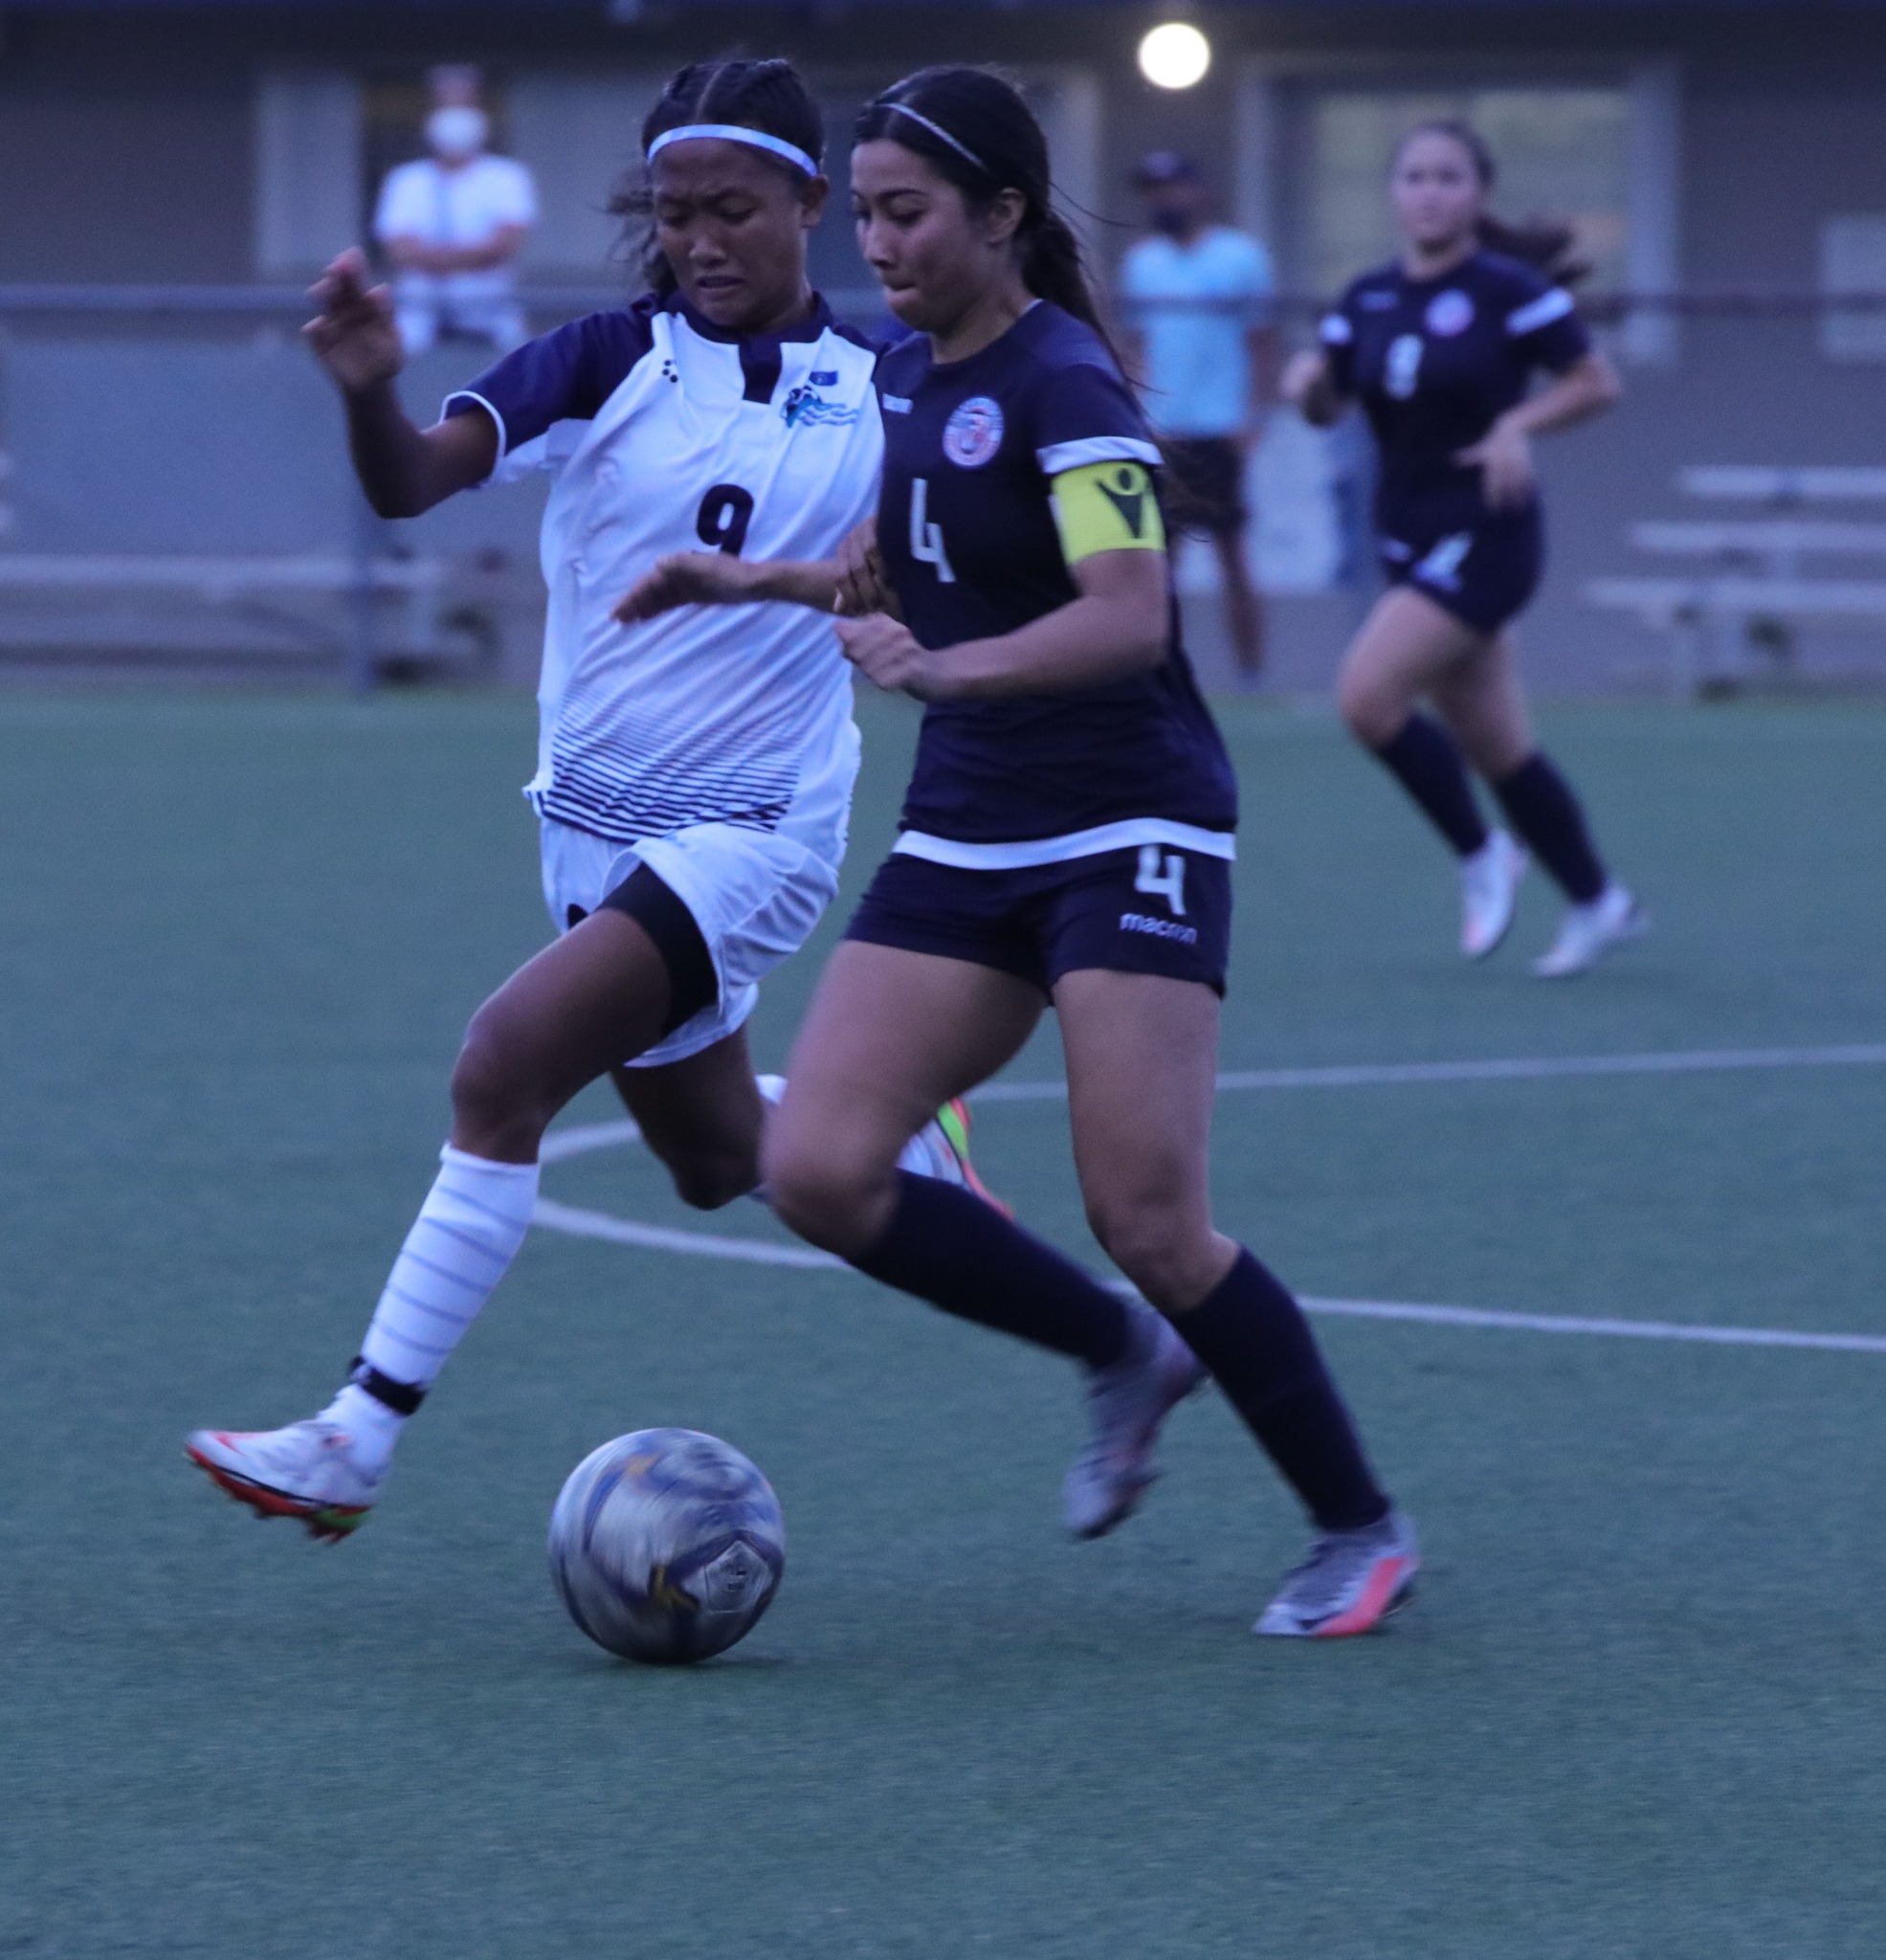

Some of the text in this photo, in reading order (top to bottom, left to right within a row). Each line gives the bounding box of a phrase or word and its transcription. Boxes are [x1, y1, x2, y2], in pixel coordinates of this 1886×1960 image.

[697, 483, 754, 558] 9
[910, 478, 956, 583] 4
[1134, 843, 1187, 916] 4
